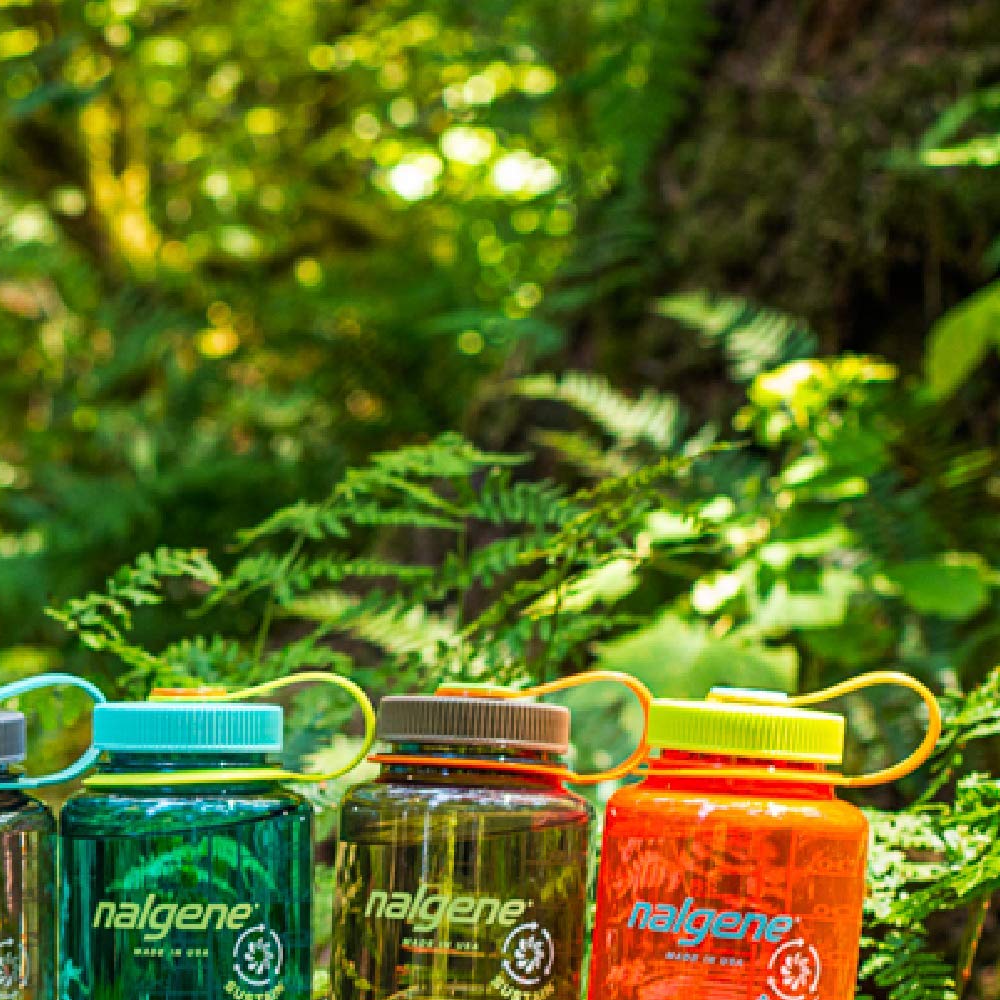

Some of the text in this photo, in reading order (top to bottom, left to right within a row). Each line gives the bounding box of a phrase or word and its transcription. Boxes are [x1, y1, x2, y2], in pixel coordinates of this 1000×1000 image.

[93, 893, 253, 942] nalgene
[365, 883, 528, 932] nalgene
[627, 897, 794, 947] nalgene
